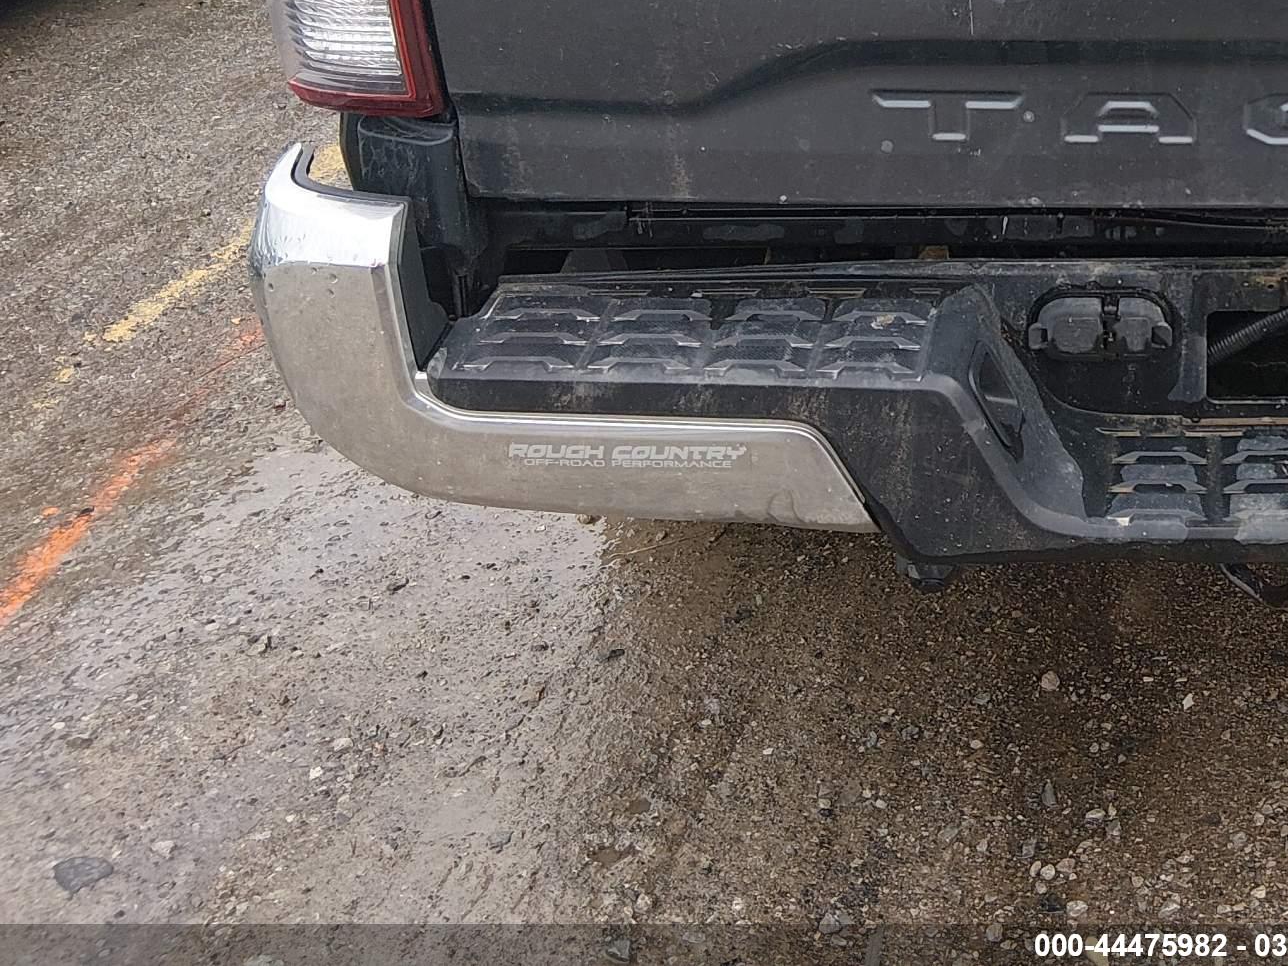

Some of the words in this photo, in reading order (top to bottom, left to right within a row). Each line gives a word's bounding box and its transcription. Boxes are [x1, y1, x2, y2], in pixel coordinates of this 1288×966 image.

[508, 442, 605, 459] ROUGH
[612, 442, 747, 460] COUNTRY
[524, 458, 606, 467] OFF-ROAD
[611, 458, 733, 468] PERFORMANCE
